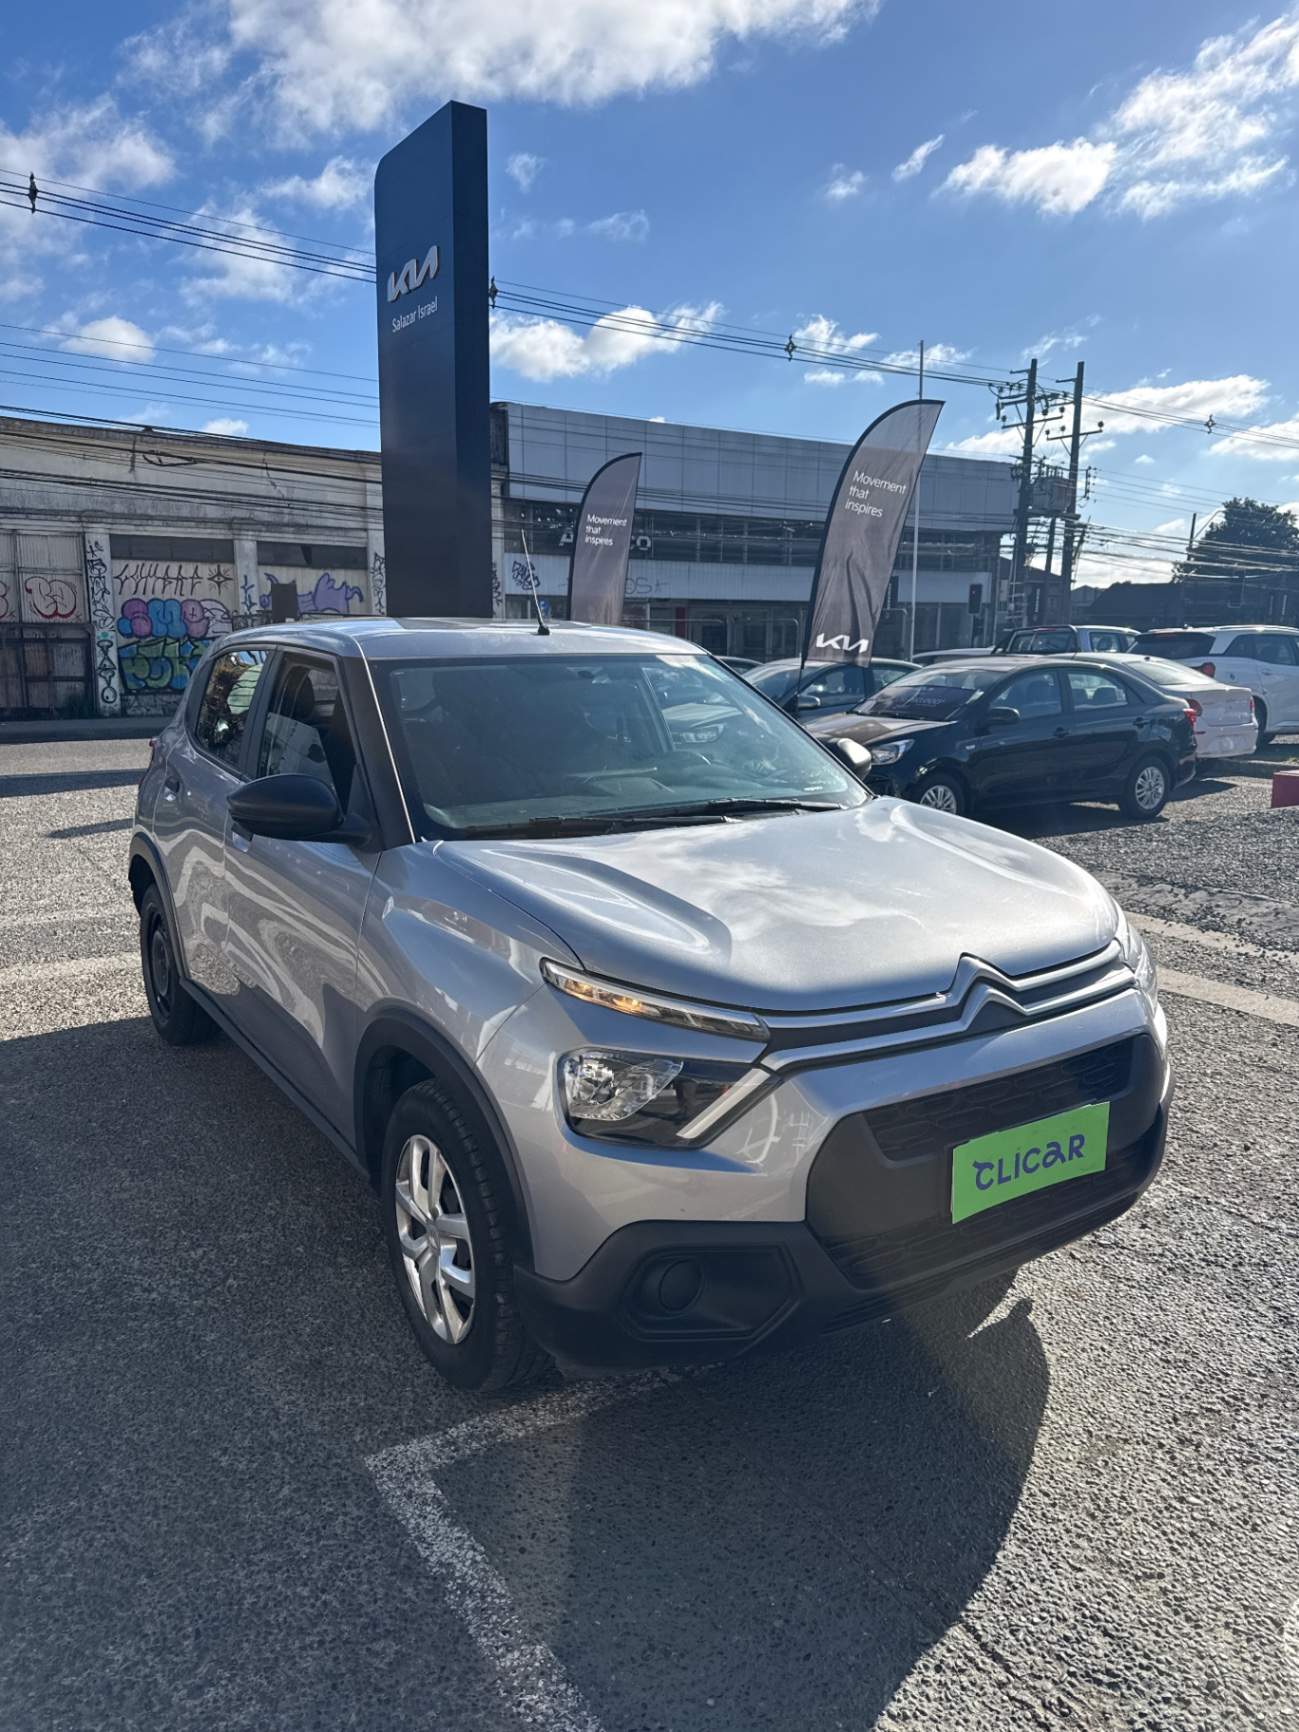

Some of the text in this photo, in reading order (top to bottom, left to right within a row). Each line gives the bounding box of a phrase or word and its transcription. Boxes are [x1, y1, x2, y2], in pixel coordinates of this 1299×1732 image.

[392, 296, 438, 333] Salazar Israel
[853, 470, 907, 495] Movement
[849, 485, 869, 500] that
[845, 498, 883, 518] inspires
[587, 513, 628, 527] Movement
[585, 525, 602, 535] that
[584, 534, 614, 547] inspires
